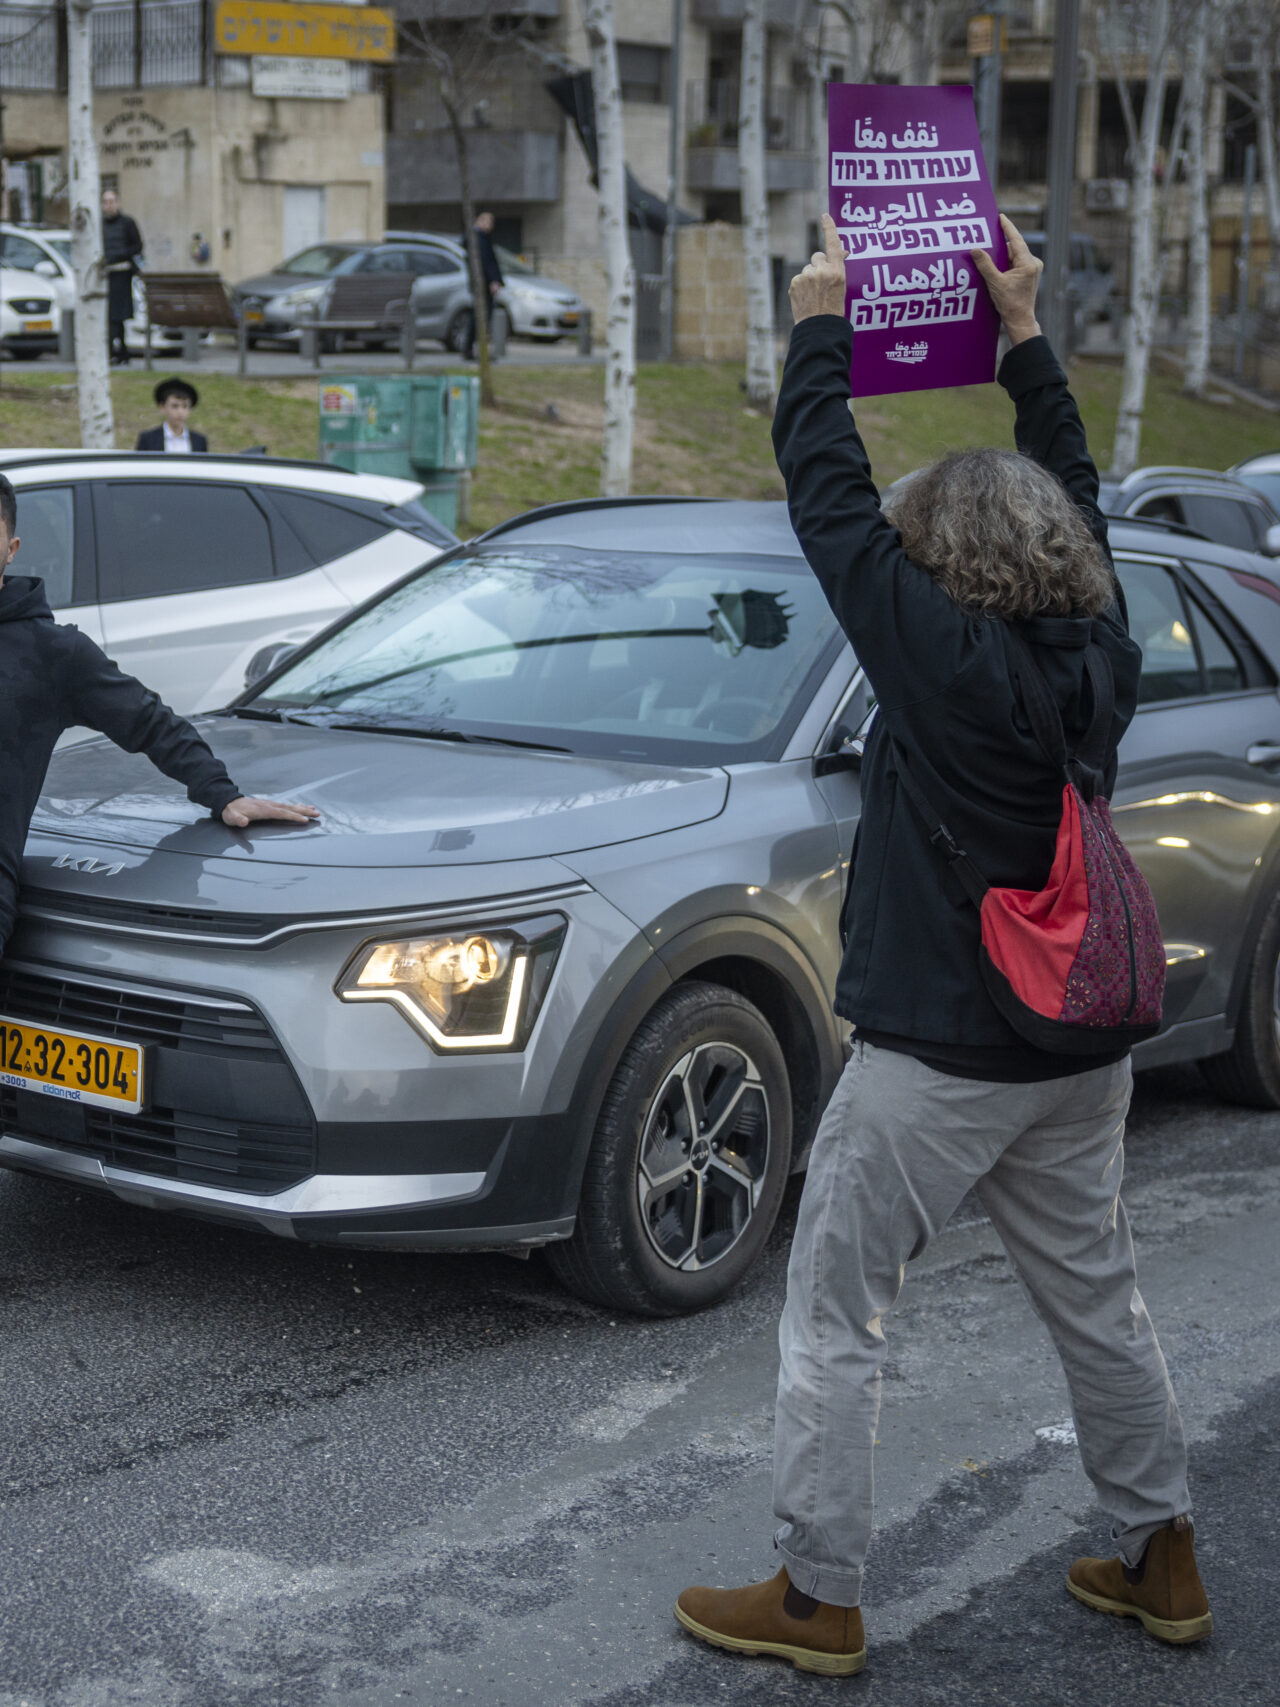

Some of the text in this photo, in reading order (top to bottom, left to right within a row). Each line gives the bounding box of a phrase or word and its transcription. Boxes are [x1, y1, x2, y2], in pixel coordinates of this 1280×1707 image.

[892, 121, 939, 149] نقف
[835, 156, 972, 180] עומדות ביחד
[840, 192, 977, 230] ضد الجريمة
[943, 224, 986, 244] נגד
[856, 294, 970, 328] וההפקרה
[51, 853, 125, 876] KIA
